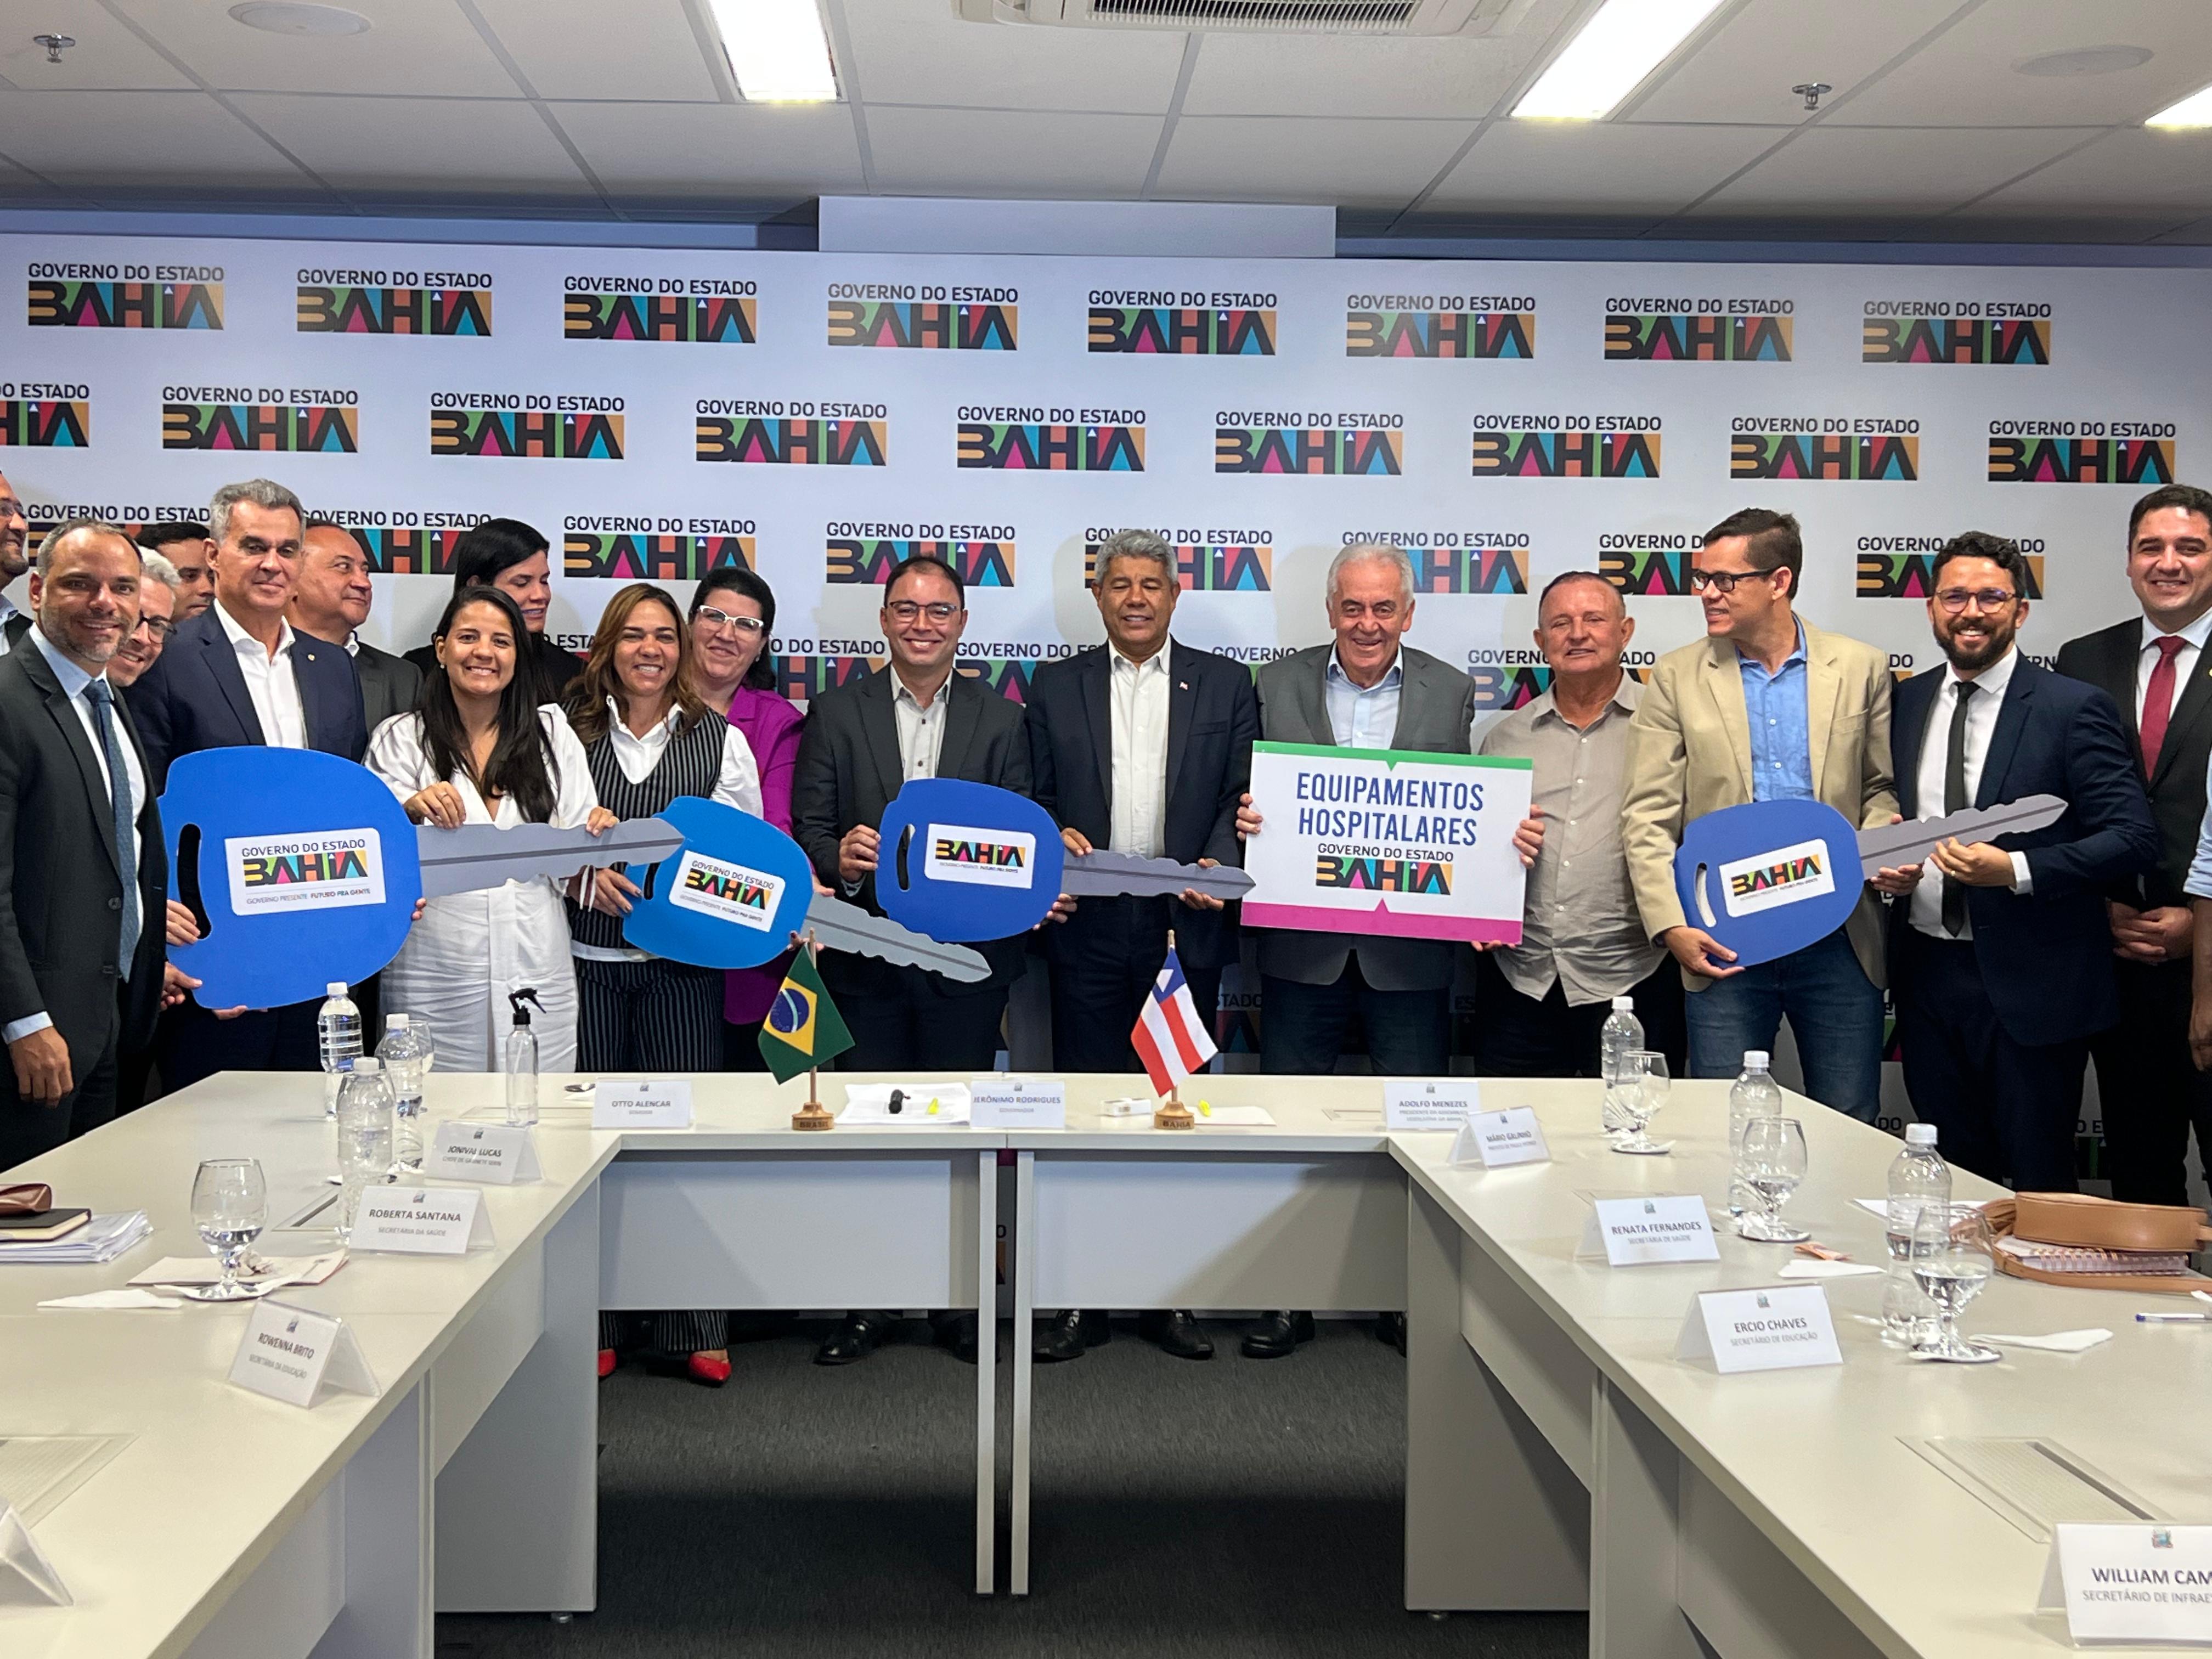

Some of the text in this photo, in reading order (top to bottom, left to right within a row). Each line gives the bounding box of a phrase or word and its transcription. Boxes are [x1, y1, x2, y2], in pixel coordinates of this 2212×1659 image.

[29, 263, 223, 280] GOVERNO DO ESTADO
[297, 269, 492, 287] GOVERNO DO ESTADO
[565, 276, 757, 295] GOVERNO DO ESTADO
[828, 284, 1018, 302] GOVERNO DO ESTADO
[28, 280, 223, 330] BAHIA
[1088, 290, 1277, 307] GOVERNO DO ESTADO
[1347, 295, 1536, 311] GOVERNO DO ESTADO
[1606, 298, 1793, 313] GOVERNO DO ESTADO
[297, 286, 492, 336] BAHIA
[564, 294, 756, 343] BAHIA
[1865, 302, 2051, 318] GOVERNO DO ESTADO
[828, 301, 1017, 351] BAHIA
[1088, 307, 1276, 356] BAHIA
[1346, 312, 1534, 359] BAHIA
[1604, 315, 1792, 361] BAHIA
[1863, 319, 2050, 365] BAHIA
[21, 384, 89, 399] ESTADO
[163, 387, 358, 404] GOVERNO DO ESTADO
[431, 393, 624, 411] GOVERNO DO ESTADO
[696, 400, 887, 418] GOVERNO DO ESTADO
[0, 400, 89, 447] HIA
[958, 407, 1146, 424] GOVERNO DO ESTADO
[1216, 411, 1403, 428] GOVERNO DO ESTADO
[1474, 415, 1661, 430] GOVERNO DO ESTADO
[163, 404, 358, 453] BAHIA
[1731, 417, 1919, 433] GOVERNO DO ESTADO
[1989, 421, 2175, 437] GOVERNO DO ESTADO
[431, 410, 624, 459] BAHIA
[696, 417, 887, 466] BAHIA
[957, 424, 1145, 472] BAHIA
[1215, 428, 1402, 475] BAHIA
[1472, 432, 1661, 478] BAHIA
[1730, 435, 1918, 481] BAHIA
[1988, 438, 2175, 483] BAHIA
[28, 505, 210, 522] GOVERNO DO ESTAD
[393, 512, 417, 526] DO
[424, 513, 492, 528] ESTADO
[565, 516, 755, 534] GOVERNO DO ESTADO
[827, 522, 1014, 540] GOVERNO DO ESTADO
[1177, 529, 1272, 544] DO ESTADO
[1342, 532, 1529, 547] GOVERNO DO ESTADO
[1600, 534, 1685, 549] GOVERNO
[1858, 537, 1943, 551] GOVERNO
[564, 533, 755, 580] BAHIA
[789, 639, 812, 653] DO
[820, 640, 884, 654] ESTADO
[957, 643, 1041, 657] GOVERNO
[1047, 644, 1071, 658] DO
[1297, 772, 1483, 811] EQUIPAMENTOS
[1299, 808, 1477, 846] HOSPITALARES
[242, 839, 365, 857] GOVERNO DO ESTADO
[935, 839, 1026, 868] BAHIA
[1318, 843, 1454, 862] GOVERNO DO ESTADO
[243, 849, 369, 887] BAHIA
[692, 860, 774, 889] GOVERNO DO ESTADO
[1316, 855, 1453, 895] BAHIA
[1731, 854, 1822, 897] BAHIA
[685, 868, 773, 910] BAHIA
[478, 1148, 501, 1157] LUCAS
[369, 1209, 461, 1221] ROBERTA SANTANA
[1612, 1221, 1702, 1235] RENATA FERNANDES
[1734, 1317, 1807, 1333] ERCIO CHAVES
[1781, 1330, 1818, 1342] EDUCAÇÃO
[257, 1333, 315, 1359] ROWENNA BRITO
[2091, 1567, 2170, 1584] WILLIAM
[2083, 1589, 2212, 1603] SECRETÁRIO DE INFRAE
